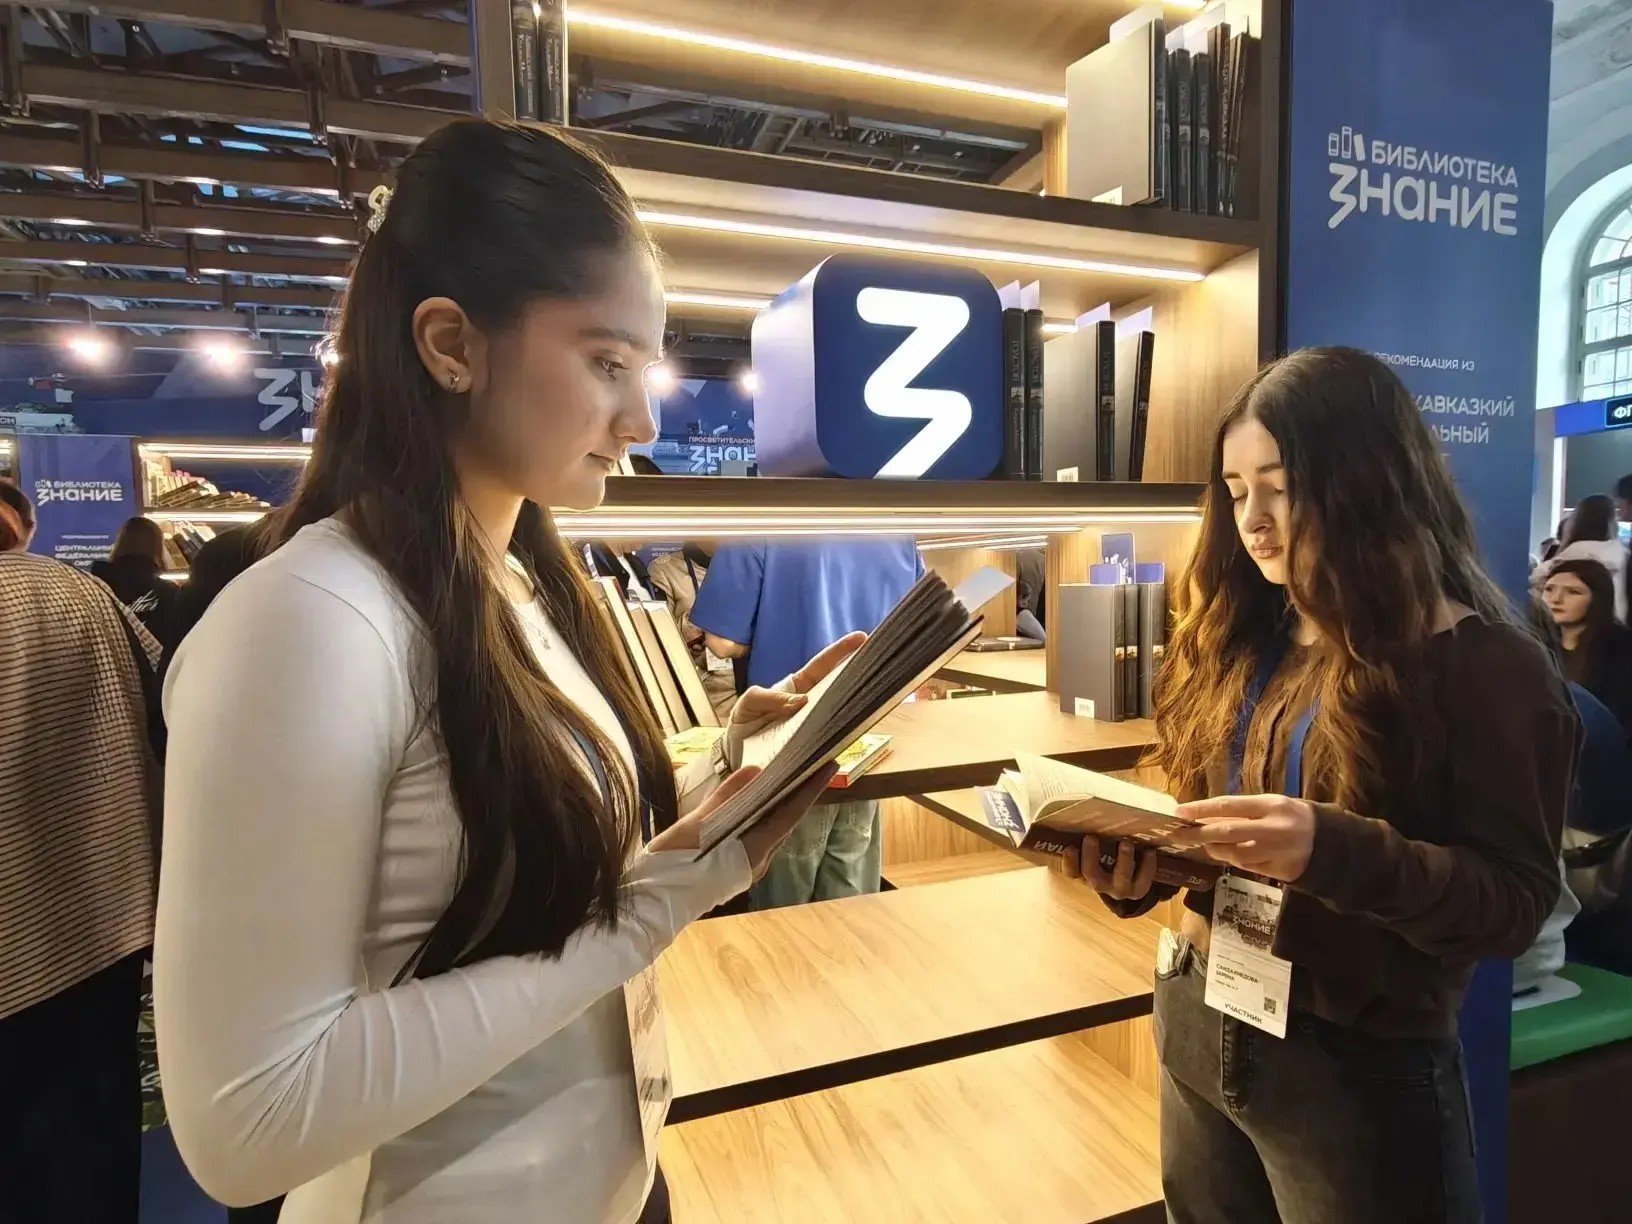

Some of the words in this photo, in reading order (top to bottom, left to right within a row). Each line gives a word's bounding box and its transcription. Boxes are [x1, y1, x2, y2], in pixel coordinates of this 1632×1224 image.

[1371, 139, 1519, 188] БИБЛИОТЕКА
[1327, 162, 1519, 236] ЗНАНИЕ
[1461, 359, 1475, 372] ИЗ
[53, 480, 122, 489] БИБЛИОТЕКА
[36, 488, 124, 507] ЗНАНИЕ
[1225, 1002, 1263, 1024] УЧАСТНИК
